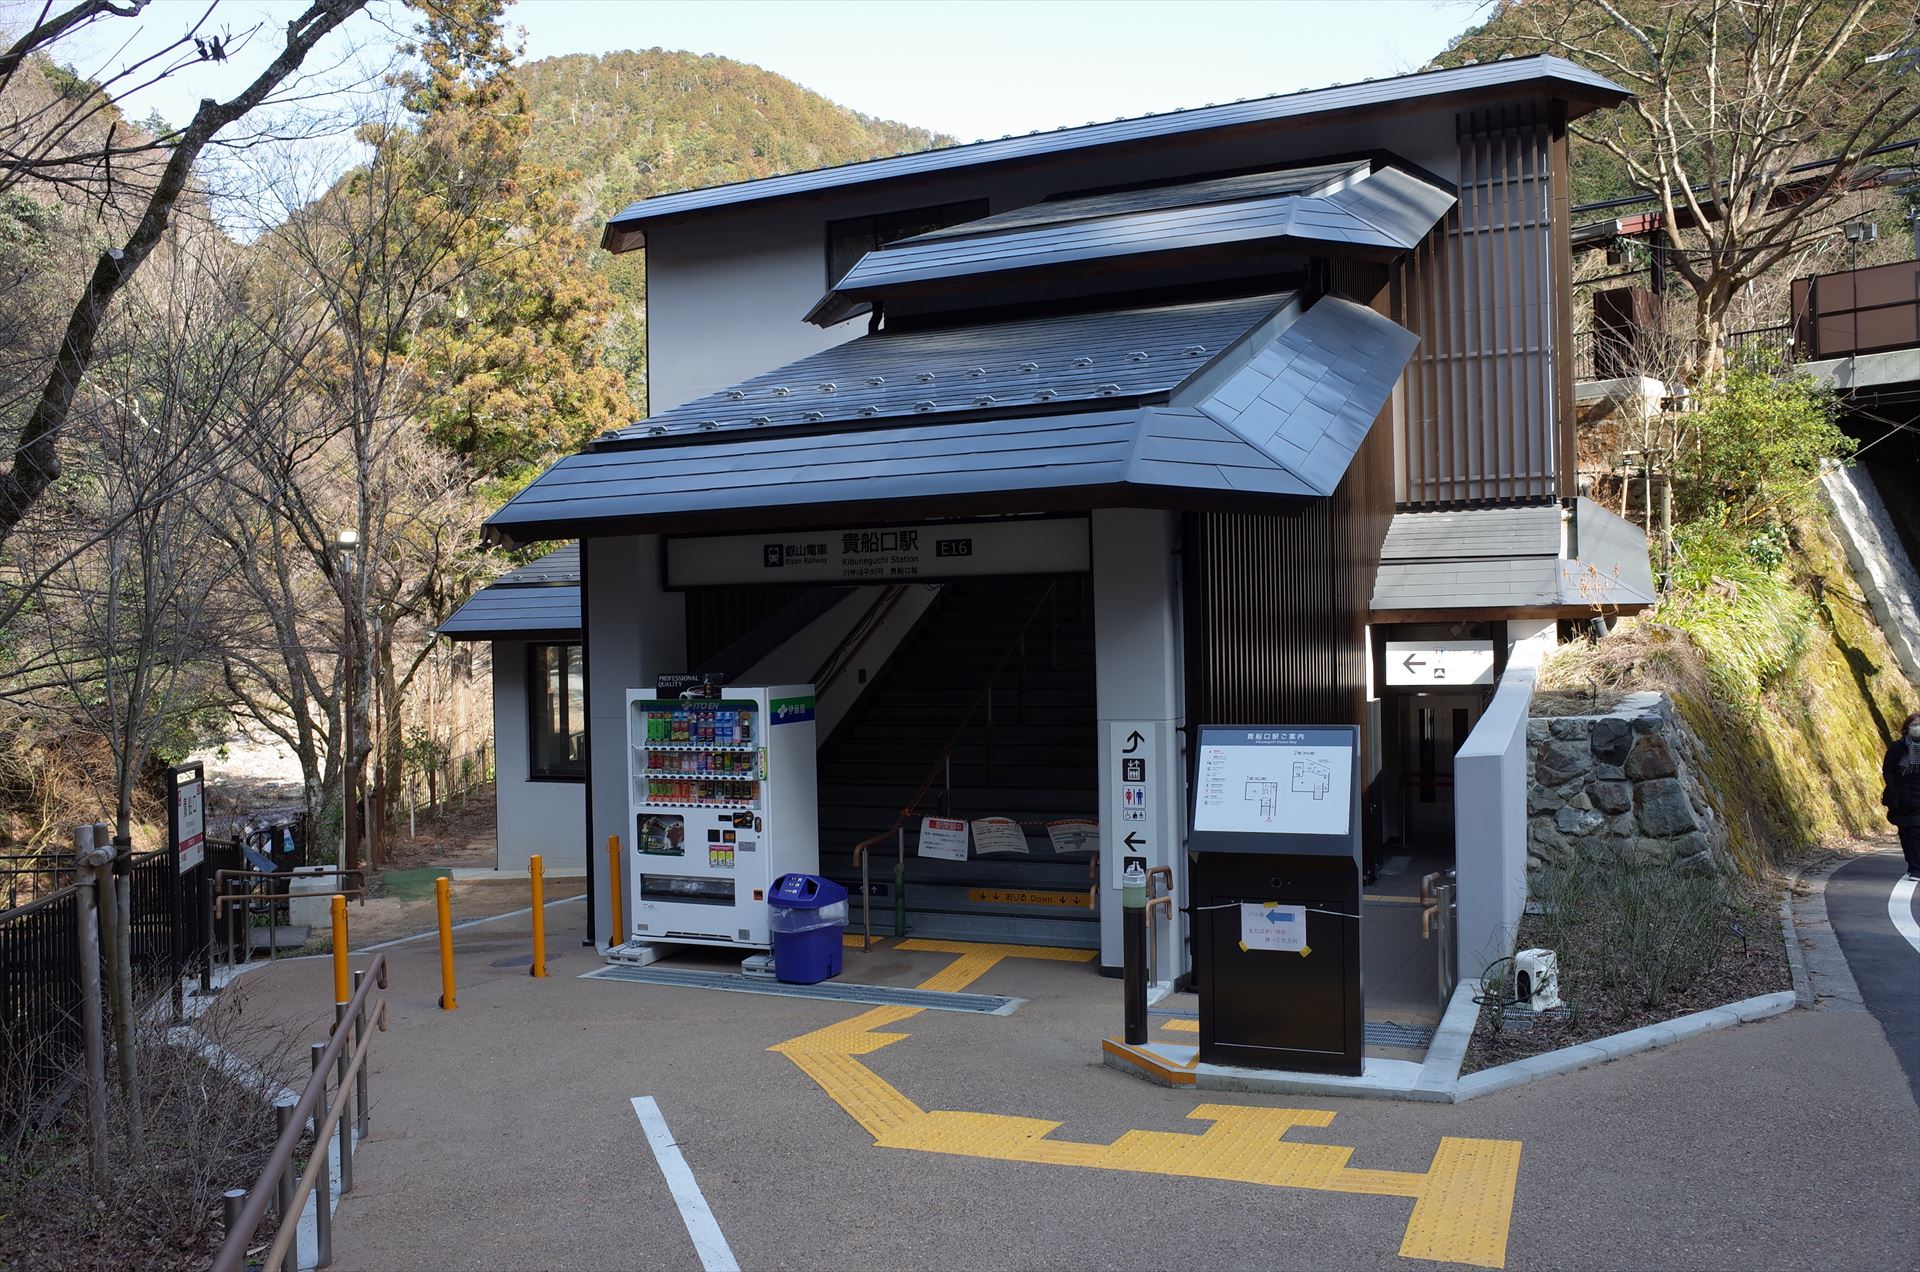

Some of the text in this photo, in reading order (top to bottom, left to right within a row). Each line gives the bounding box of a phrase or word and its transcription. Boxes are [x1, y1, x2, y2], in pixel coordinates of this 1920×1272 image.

[842, 531, 919, 554] 貴船口駅
[941, 541, 968, 555] E16
[785, 544, 828, 557] 叡山電車
[804, 557, 828, 566] Railway
[842, 555, 919, 567] Kibuneguchi Station
[693, 702, 719, 710] ITO EN
[1247, 733, 1305, 741] 貴船口駅ご案内
[1006, 893, 1053, 903] おりる Down
